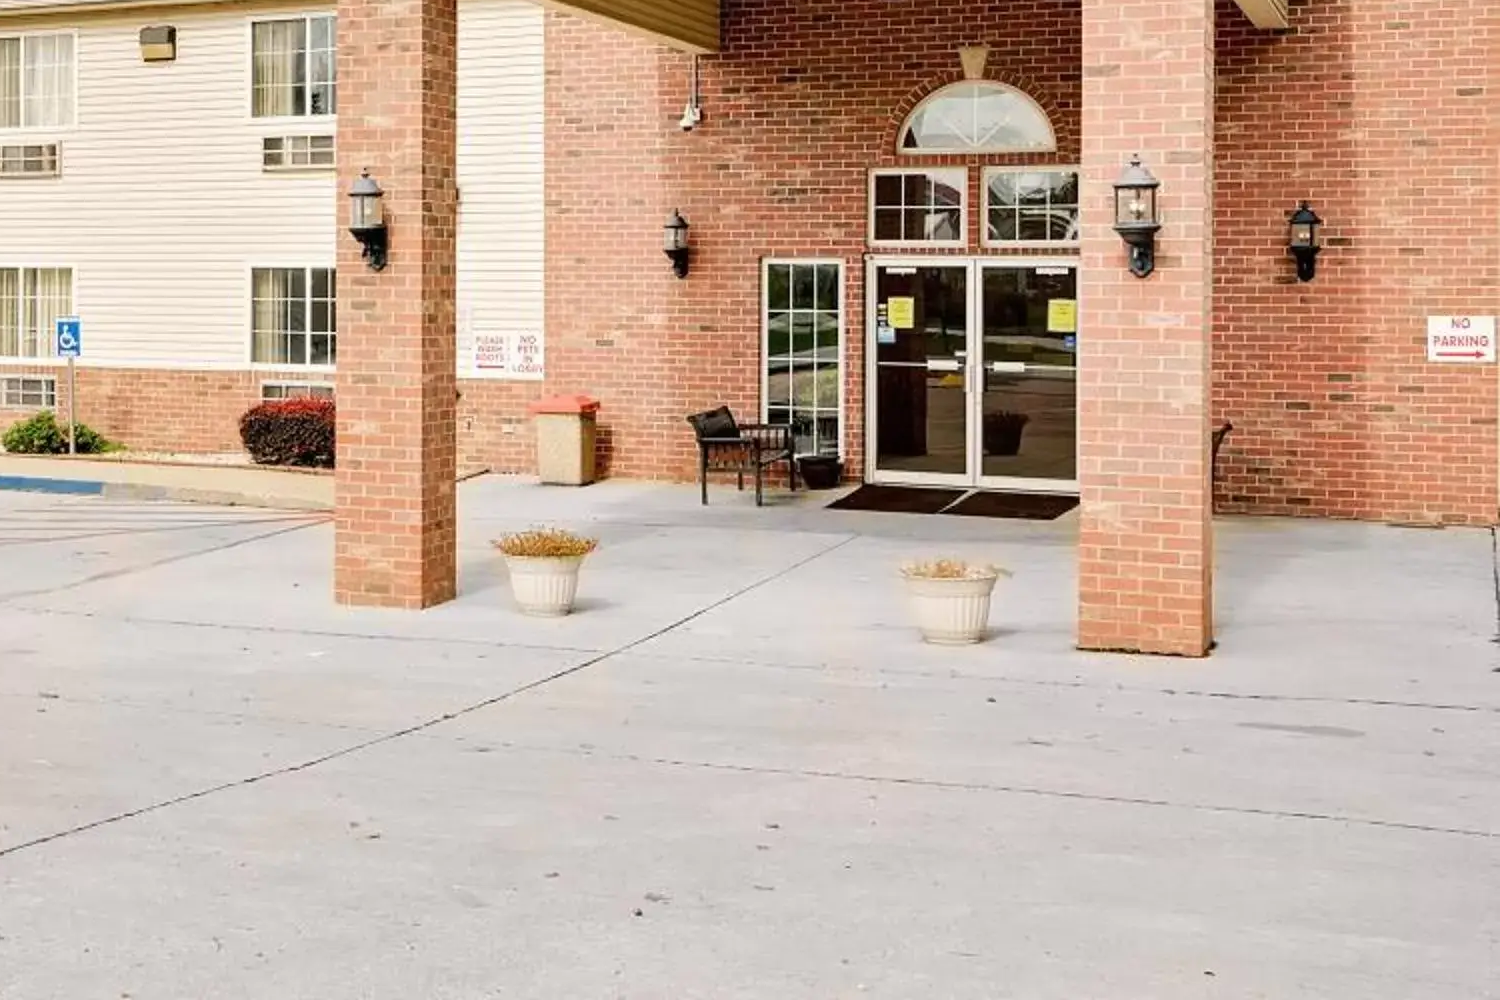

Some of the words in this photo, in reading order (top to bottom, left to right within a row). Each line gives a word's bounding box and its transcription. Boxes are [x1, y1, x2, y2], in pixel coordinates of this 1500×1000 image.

[1451, 317, 1471, 329] NO
[519, 335, 537, 345] NO
[1433, 335, 1489, 347] PARKING
